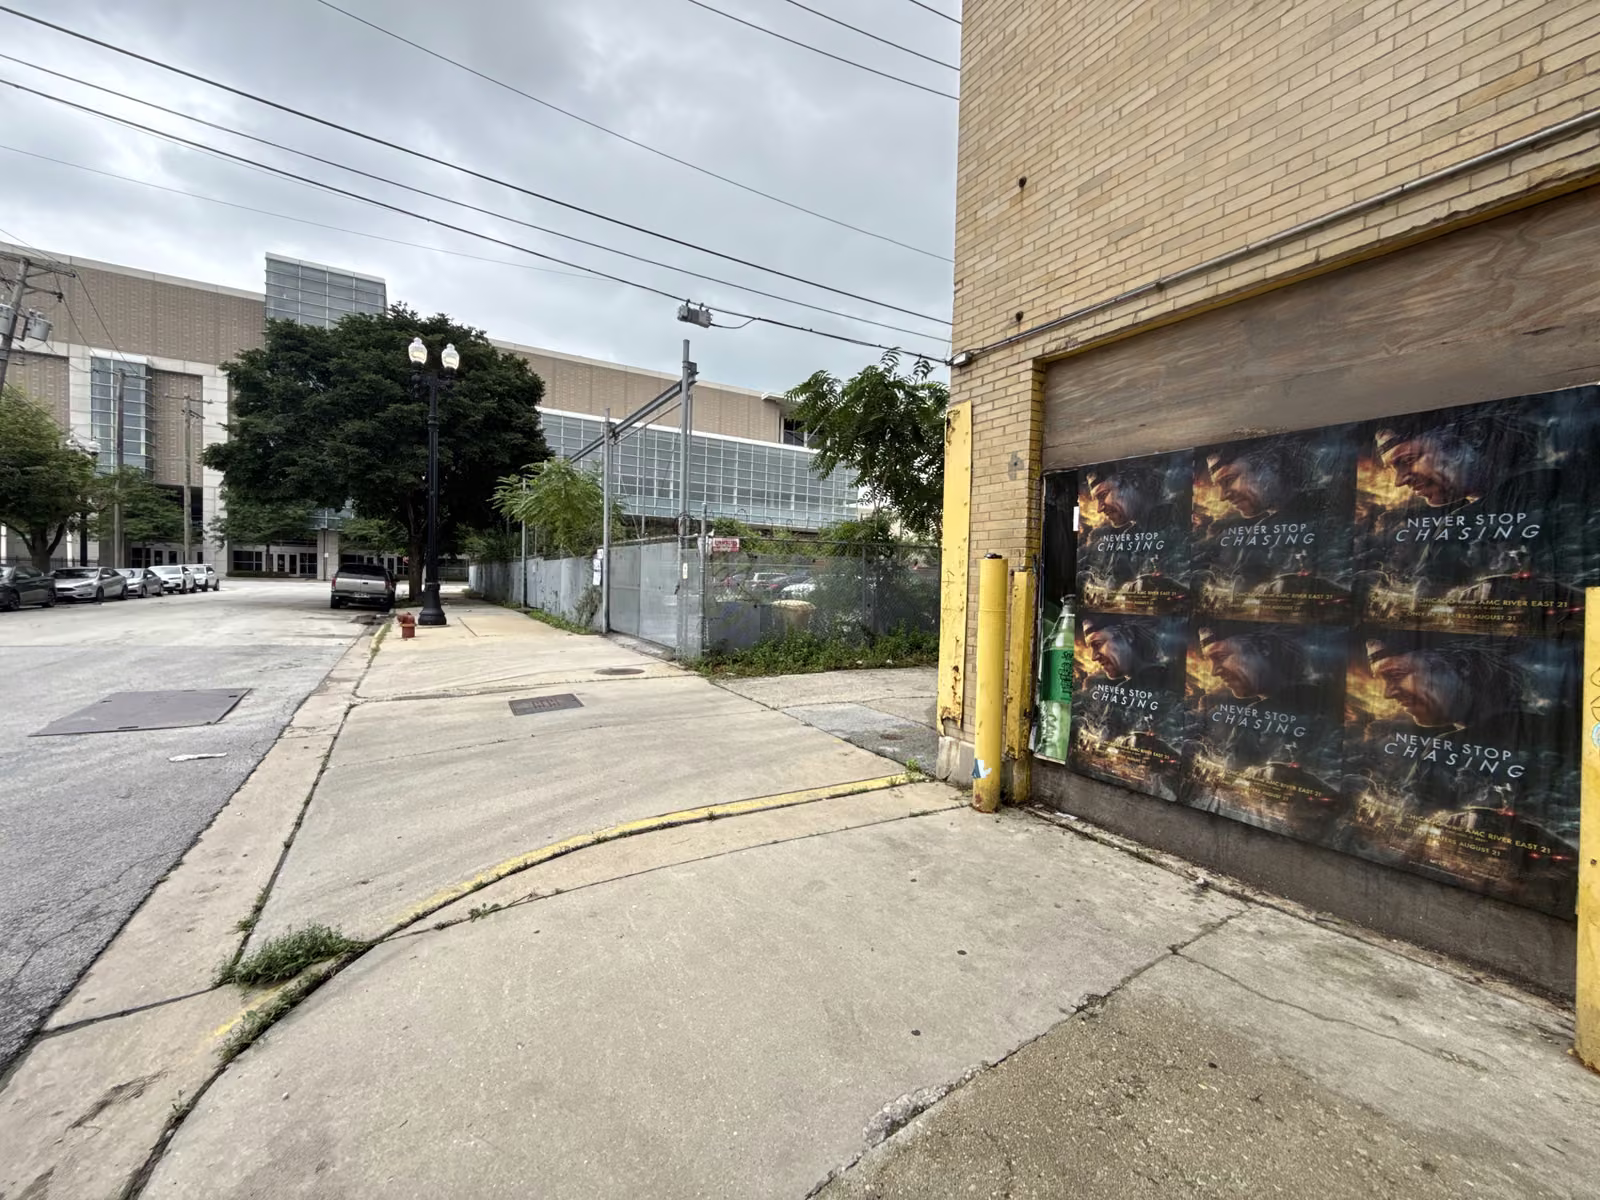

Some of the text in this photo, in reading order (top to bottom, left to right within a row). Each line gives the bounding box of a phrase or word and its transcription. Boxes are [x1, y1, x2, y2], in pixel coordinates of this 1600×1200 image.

[1407, 512, 1527, 528] NEVER STOP
[1103, 532, 1159, 542] NEVER STOP
[1228, 523, 1307, 535] NEVER STOP
[1395, 524, 1541, 542] CHASING
[1097, 540, 1165, 552] CHASING
[1220, 532, 1316, 547] CHASING
[1502, 599, 1528, 607] RIVER
[1473, 613, 1505, 621] AUGUST
[1097, 684, 1153, 700] NEVER STOP
[1091, 690, 1159, 711] CHASING
[1220, 703, 1297, 724] NEVER STOP
[1212, 711, 1307, 737] CHASING
[1395, 732, 1512, 761] NEVER STOP
[1384, 742, 1526, 778] CHASING
[1298, 786, 1314, 795] EAST
[1459, 841, 1489, 853] AUGUST
[1491, 849, 1501, 857] 21
[1465, 828, 1485, 838] AMC
[1488, 833, 1513, 844] RIVER
[1515, 840, 1538, 850] EAST
[1540, 846, 1551, 854] 21
